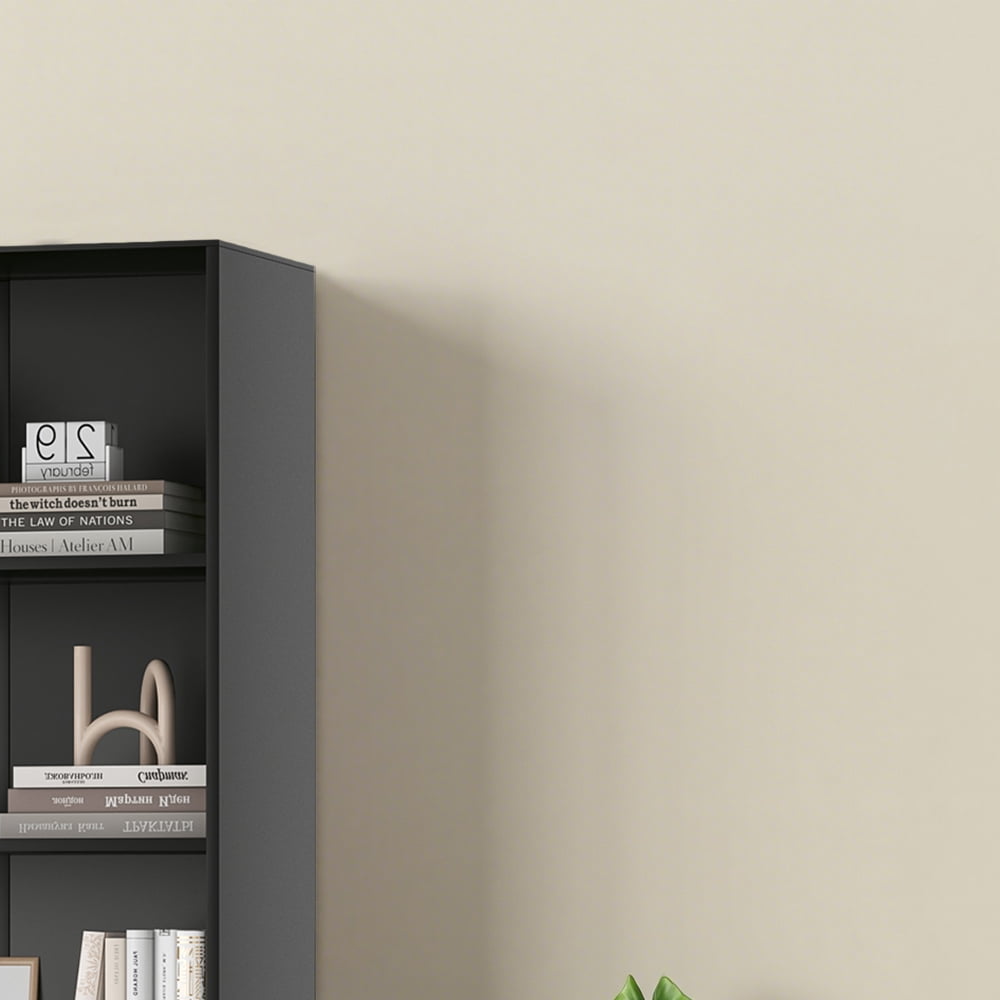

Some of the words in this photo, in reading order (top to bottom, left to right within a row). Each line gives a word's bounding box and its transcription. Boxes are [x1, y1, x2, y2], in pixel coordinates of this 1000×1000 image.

[11, 485, 67, 494] PHOTOGRAPHS
[68, 485, 77, 493] BY
[116, 483, 148, 492] HALARD
[1, 517, 25, 527] THE
[30, 517, 55, 527] LAW
[59, 516, 75, 526] OF
[80, 515, 134, 526] NATIONS
[0, 539, 47, 554] Houses
[59, 537, 104, 553] Atelier
[104, 537, 134, 552] AM
